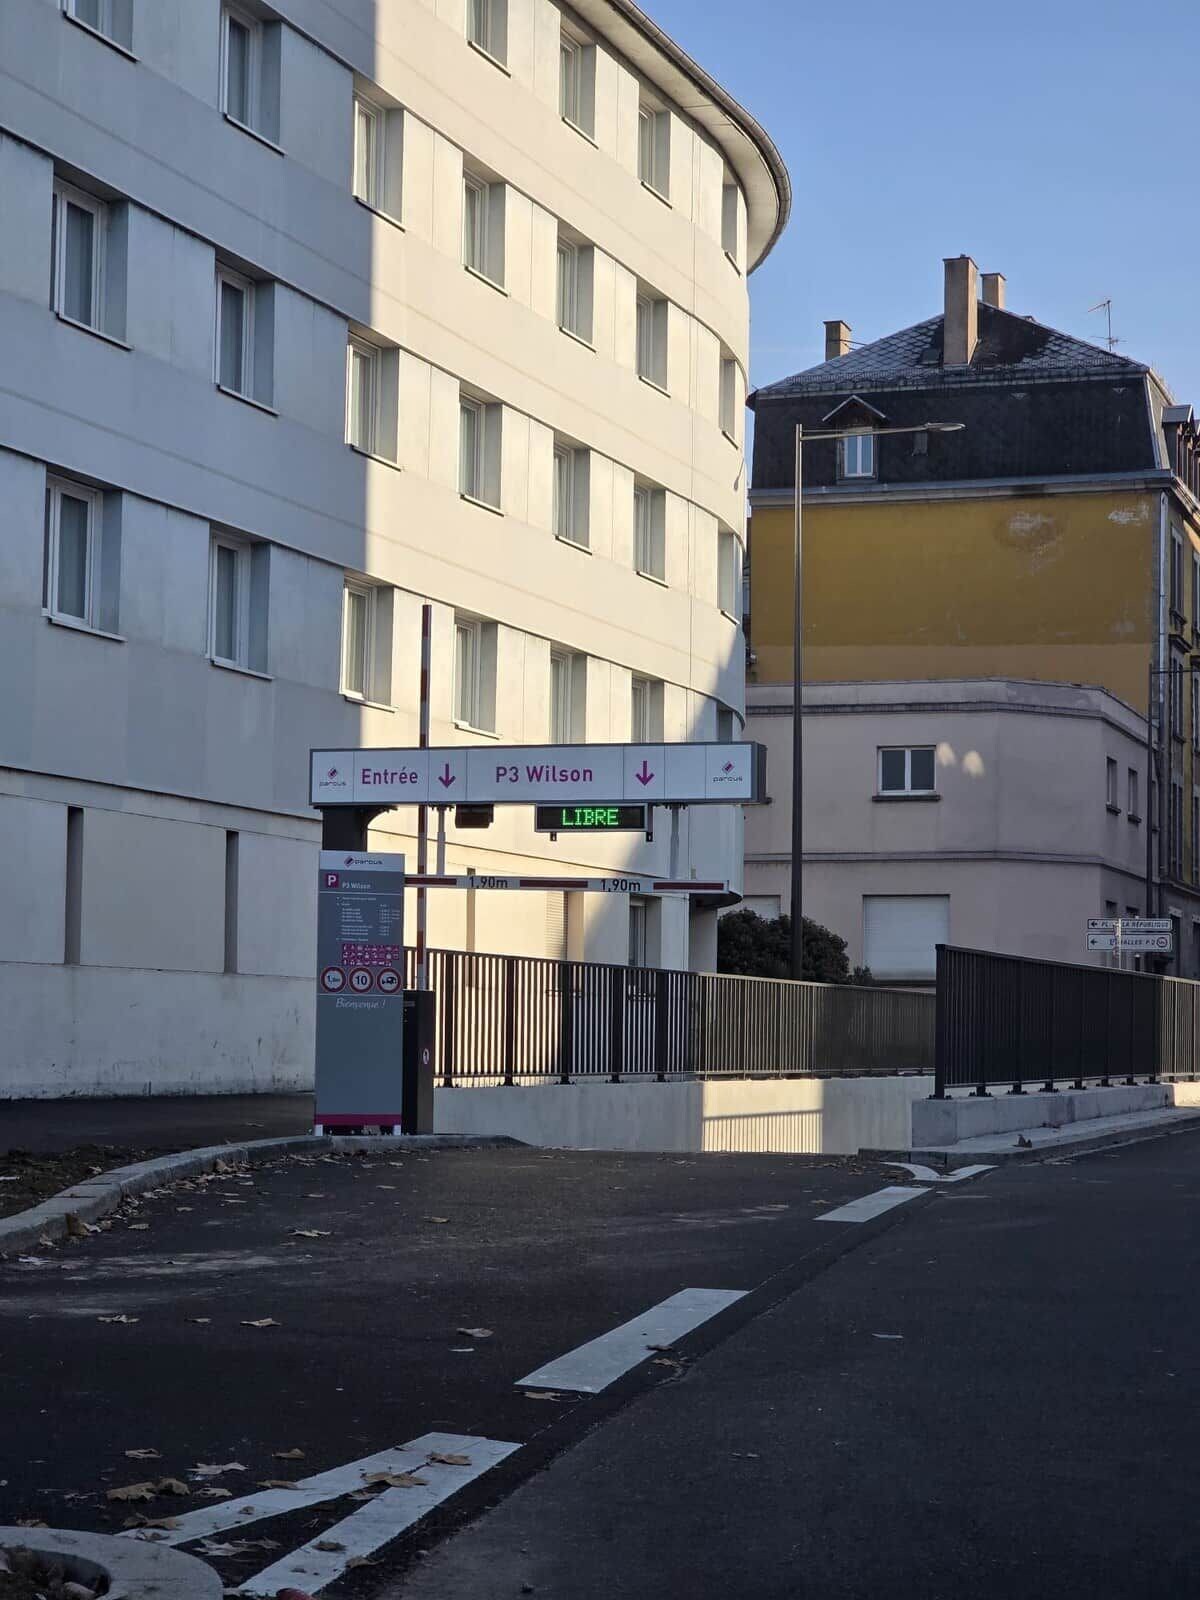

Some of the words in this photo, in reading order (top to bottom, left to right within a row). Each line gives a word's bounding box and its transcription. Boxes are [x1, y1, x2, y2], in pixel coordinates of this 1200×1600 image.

[361, 766, 418, 785] Entrée
[495, 766, 520, 783] P3
[526, 764, 593, 783] Wilson
[562, 808, 619, 826] LIBRE
[327, 875, 337, 886] P
[601, 879, 641, 892] 1,90m
[356, 975, 368, 985] 10
